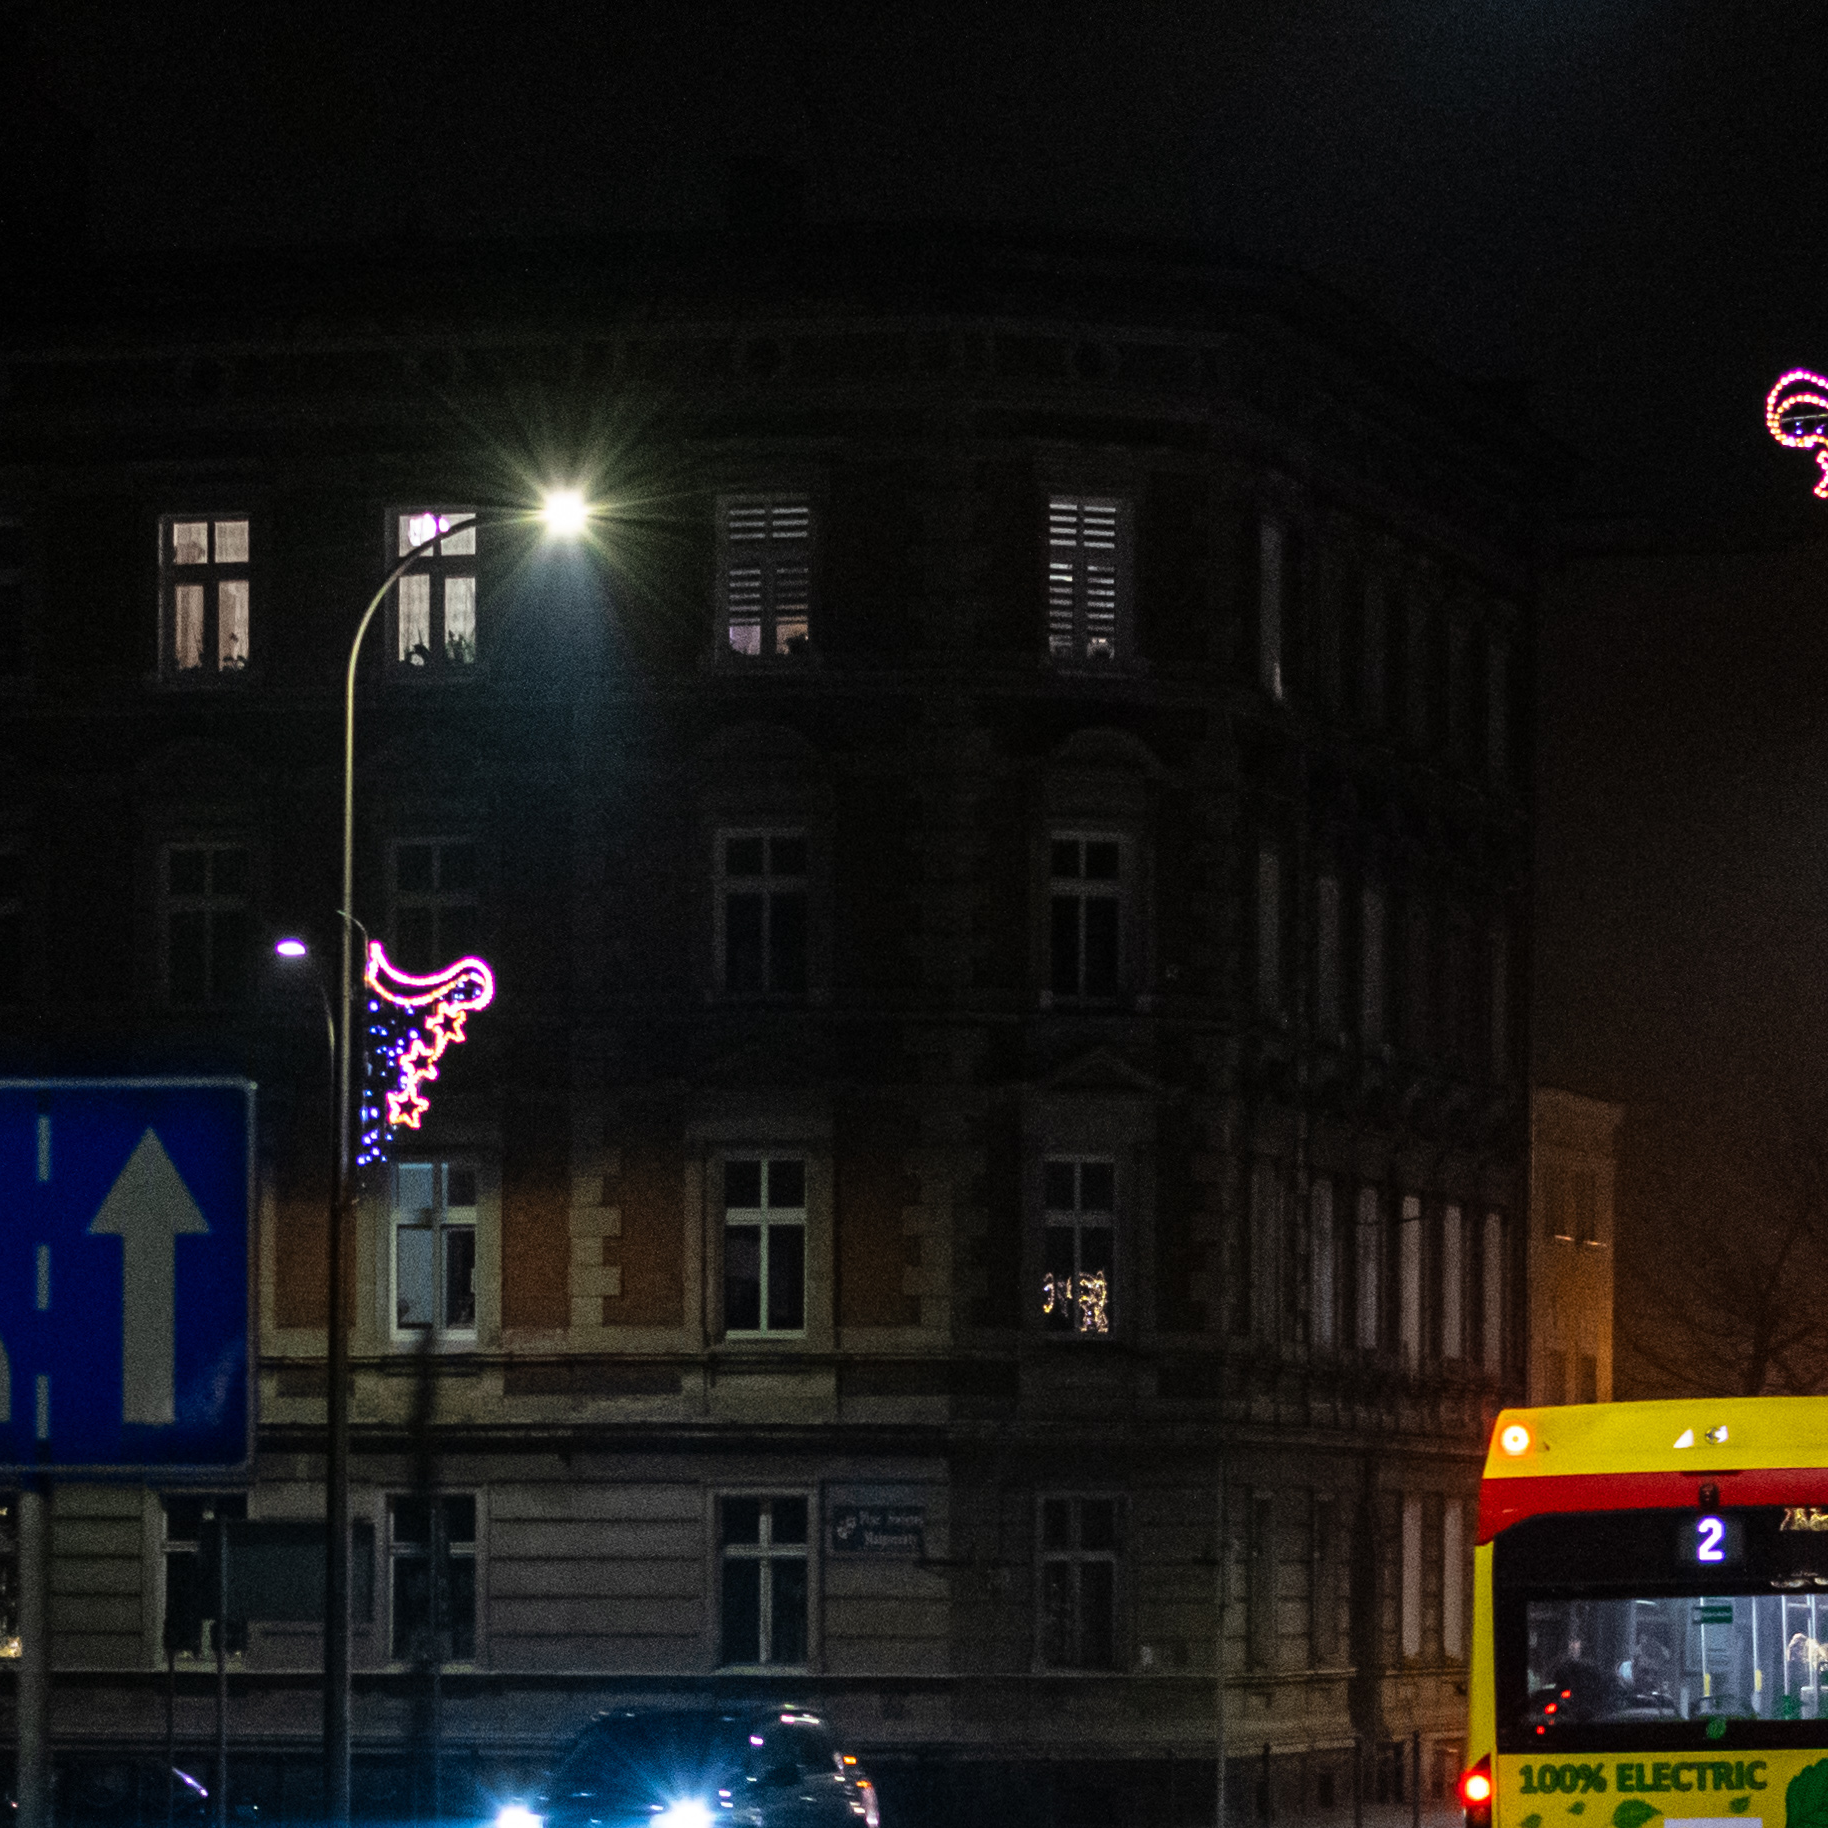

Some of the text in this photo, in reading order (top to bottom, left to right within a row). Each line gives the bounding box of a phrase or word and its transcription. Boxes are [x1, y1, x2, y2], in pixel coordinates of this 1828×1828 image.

[1697, 1515, 1726, 1562] 2
[1519, 1761, 1768, 1795] 100% ELECTRIC
